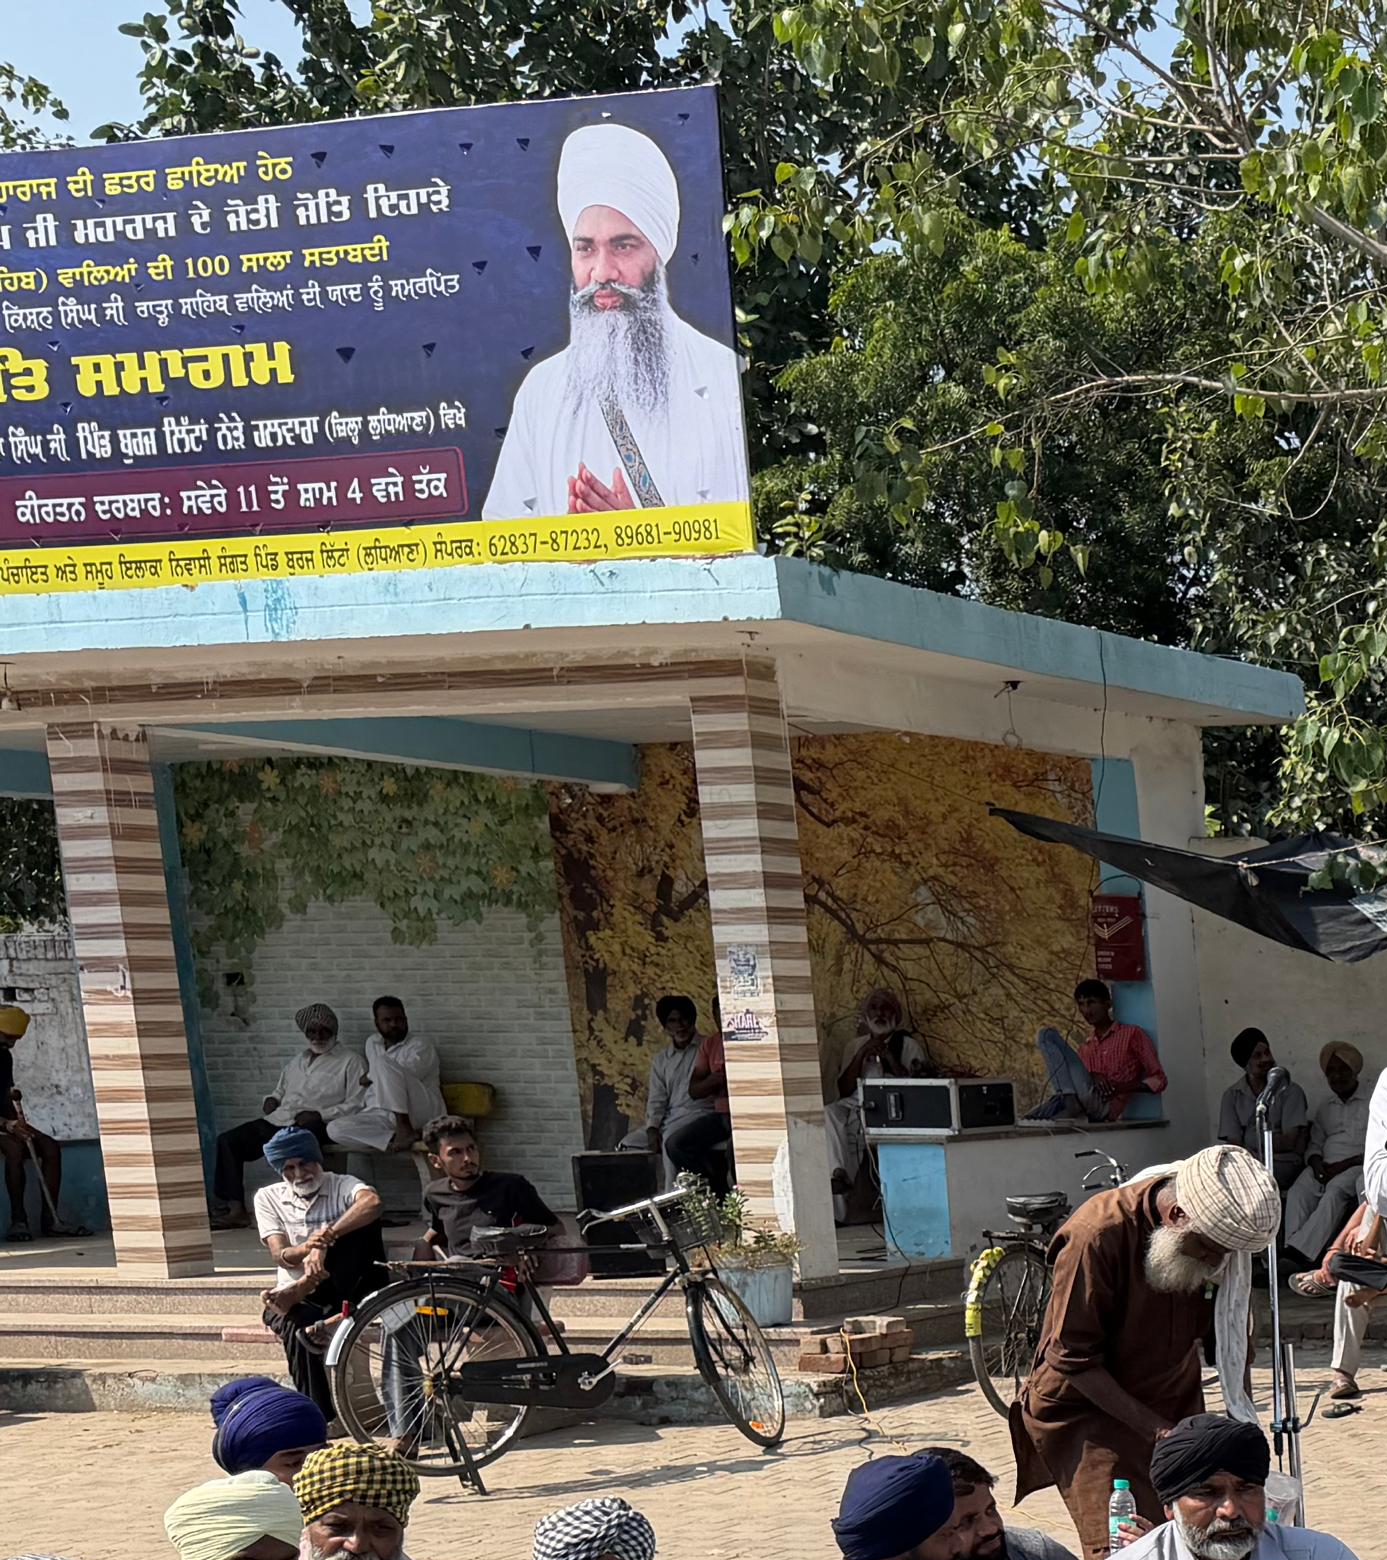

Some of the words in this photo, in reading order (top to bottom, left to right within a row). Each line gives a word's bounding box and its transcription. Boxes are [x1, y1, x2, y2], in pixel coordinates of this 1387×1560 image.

[67, 167, 94, 197] ਦੀ
[103, 170, 156, 196] ਛਤਰ
[166, 157, 247, 190] ਛਾਇਆ
[256, 151, 293, 181] ਹੇਠ
[23, 213, 60, 248] ਜੀ
[71, 212, 177, 245] ਮਹਾਰਾਜ
[188, 200, 211, 235] ਦੇ
[224, 194, 281, 231] ਜੋਤੀ
[294, 188, 351, 226] ਜੋਤਿ
[364, 177, 451, 219] ਦਿਹਾੜੇ
[57, 258, 138, 288] ਵਾਲਿਆਂ
[147, 254, 174, 281] ਦੀ
[185, 255, 230, 278] 100
[240, 250, 293, 273] ਸਾਲਾ
[302, 234, 390, 268] ਸਤਾਬਦੀ
[58, 296, 100, 330] ਸਿੰਘ
[103, 293, 128, 325] ਜੀ
[179, 289, 231, 319] ਸਾਹਿਬ
[234, 284, 294, 313] ਵਾਲਿਆਂ
[300, 280, 324, 308] ਦੀ
[327, 284, 363, 306] ਯਾਦ
[368, 275, 385, 311] ਨੂੰ
[389, 268, 460, 300] ਸਮਰਪਿਤ
[71, 341, 295, 397] ਸਮਾਗਮ
[9, 426, 47, 464] ਸਿੰਘ
[48, 424, 70, 461] ਜੀ
[77, 422, 111, 459] ਪਿੰਡ
[117, 428, 157, 464] ਬੁਰਜ
[215, 412, 245, 450] ਨੇੜੇ
[251, 416, 320, 447] ਹਲਵਾਰਾ
[367, 407, 435, 440] ਲੁਧਿਆਣਾ)
[439, 401, 466, 429] ਵਿਖੇ
[15, 491, 86, 524] ਕੀਰਤਨ
[180, 480, 228, 515] ਸਵੇਰੇ
[237, 484, 261, 512] 11
[268, 474, 289, 510] ਤੋਂ
[297, 481, 338, 507] ਸ਼ਾਮ
[347, 478, 363, 505] 4
[371, 467, 403, 503] ਵਜੇ
[412, 465, 448, 499] ਤੱਕ
[0, 558, 48, 585] ਪੰਚਾਇਤ
[55, 556, 78, 583] ਅਤੇ
[84, 561, 113, 589] ਸਮੂਹ
[119, 554, 163, 579] ਇਲਾਕਾ
[169, 548, 212, 578] ਨਿਵਾਸੀ
[217, 546, 249, 574] ਸੰਗਤ
[254, 544, 278, 572] ਪਿੰਡ
[285, 550, 315, 575] ਬੁਰਜ
[357, 538, 427, 571] (ਲੁਧਿਆਣਾ)
[614, 519, 721, 548] 89681-90981
